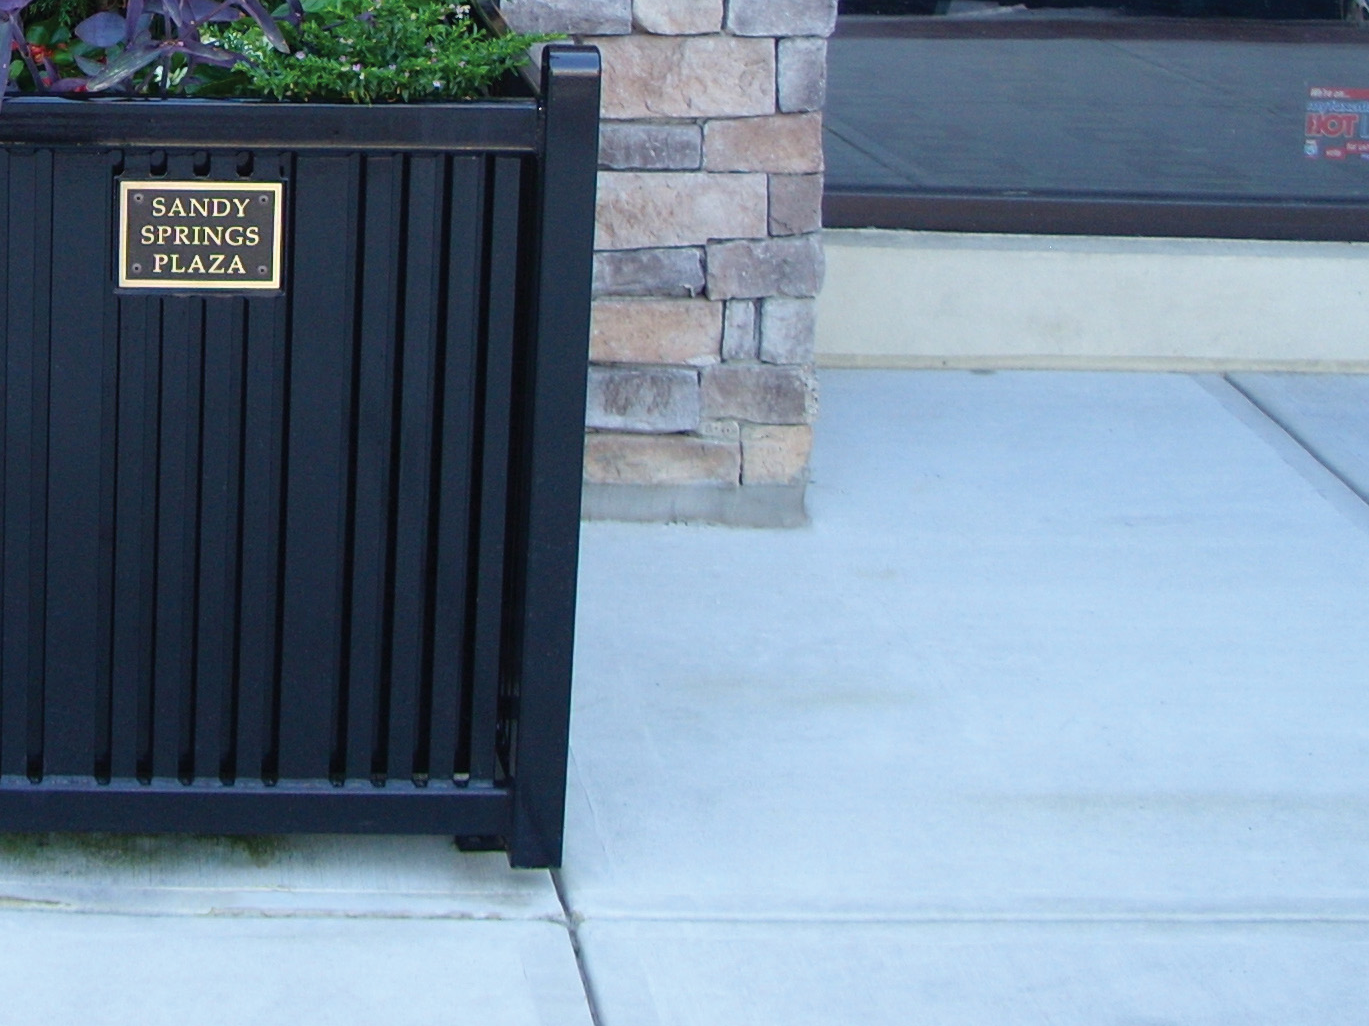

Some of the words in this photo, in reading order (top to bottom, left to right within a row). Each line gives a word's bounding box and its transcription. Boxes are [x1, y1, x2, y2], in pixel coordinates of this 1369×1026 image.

[152, 197, 250, 217] SANDY
[140, 225, 259, 246] SPRINGS
[152, 254, 246, 274] PLAZA
